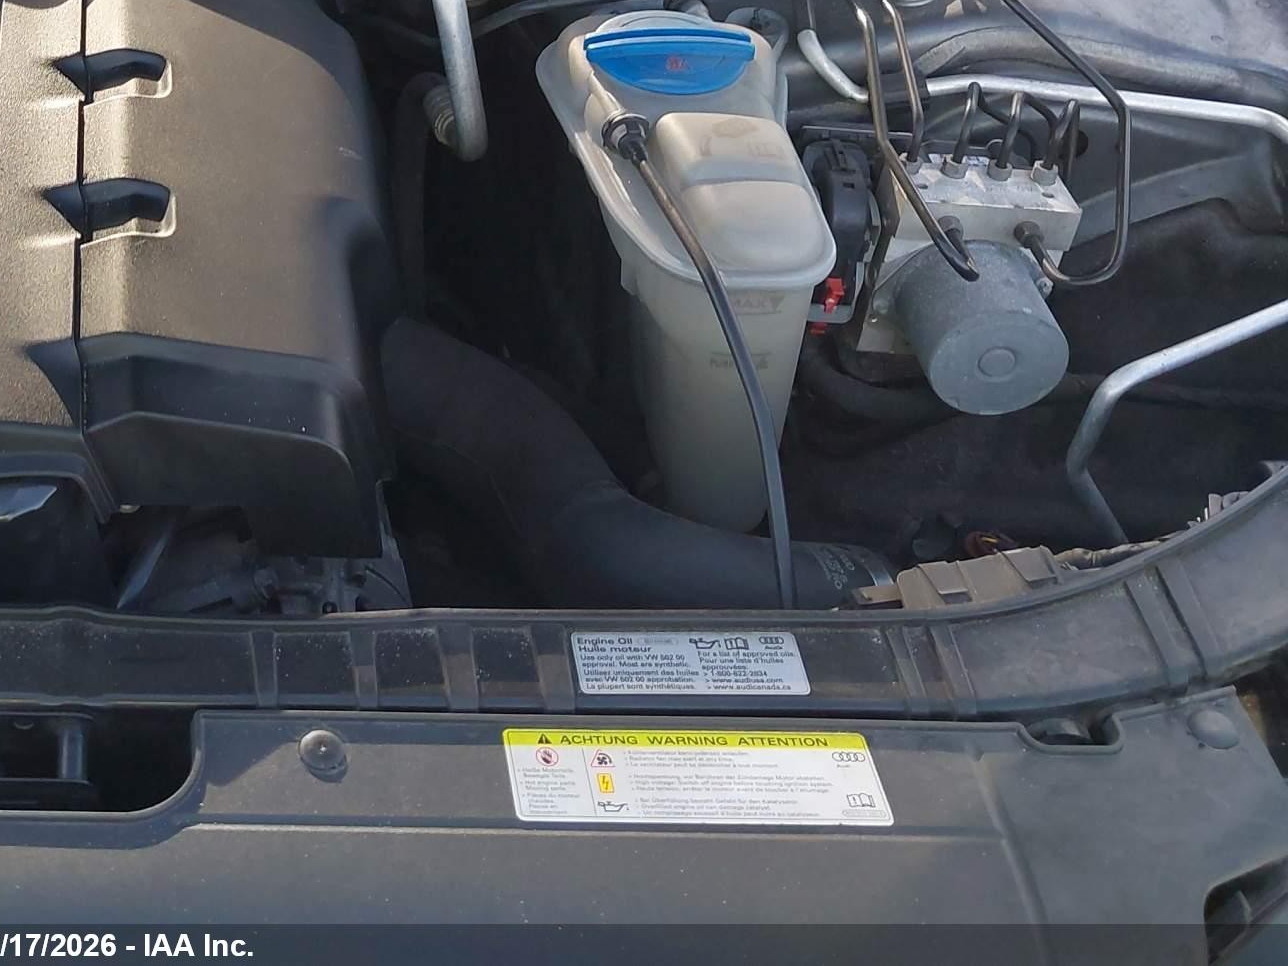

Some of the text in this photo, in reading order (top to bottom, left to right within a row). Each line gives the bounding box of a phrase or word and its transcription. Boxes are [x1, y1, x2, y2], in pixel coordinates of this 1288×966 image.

[577, 637, 615, 647] Engine
[617, 637, 633, 645] Oil
[578, 645, 607, 653] Huile
[559, 734, 829, 747] ACHTUNG WARNING ATTENTION
